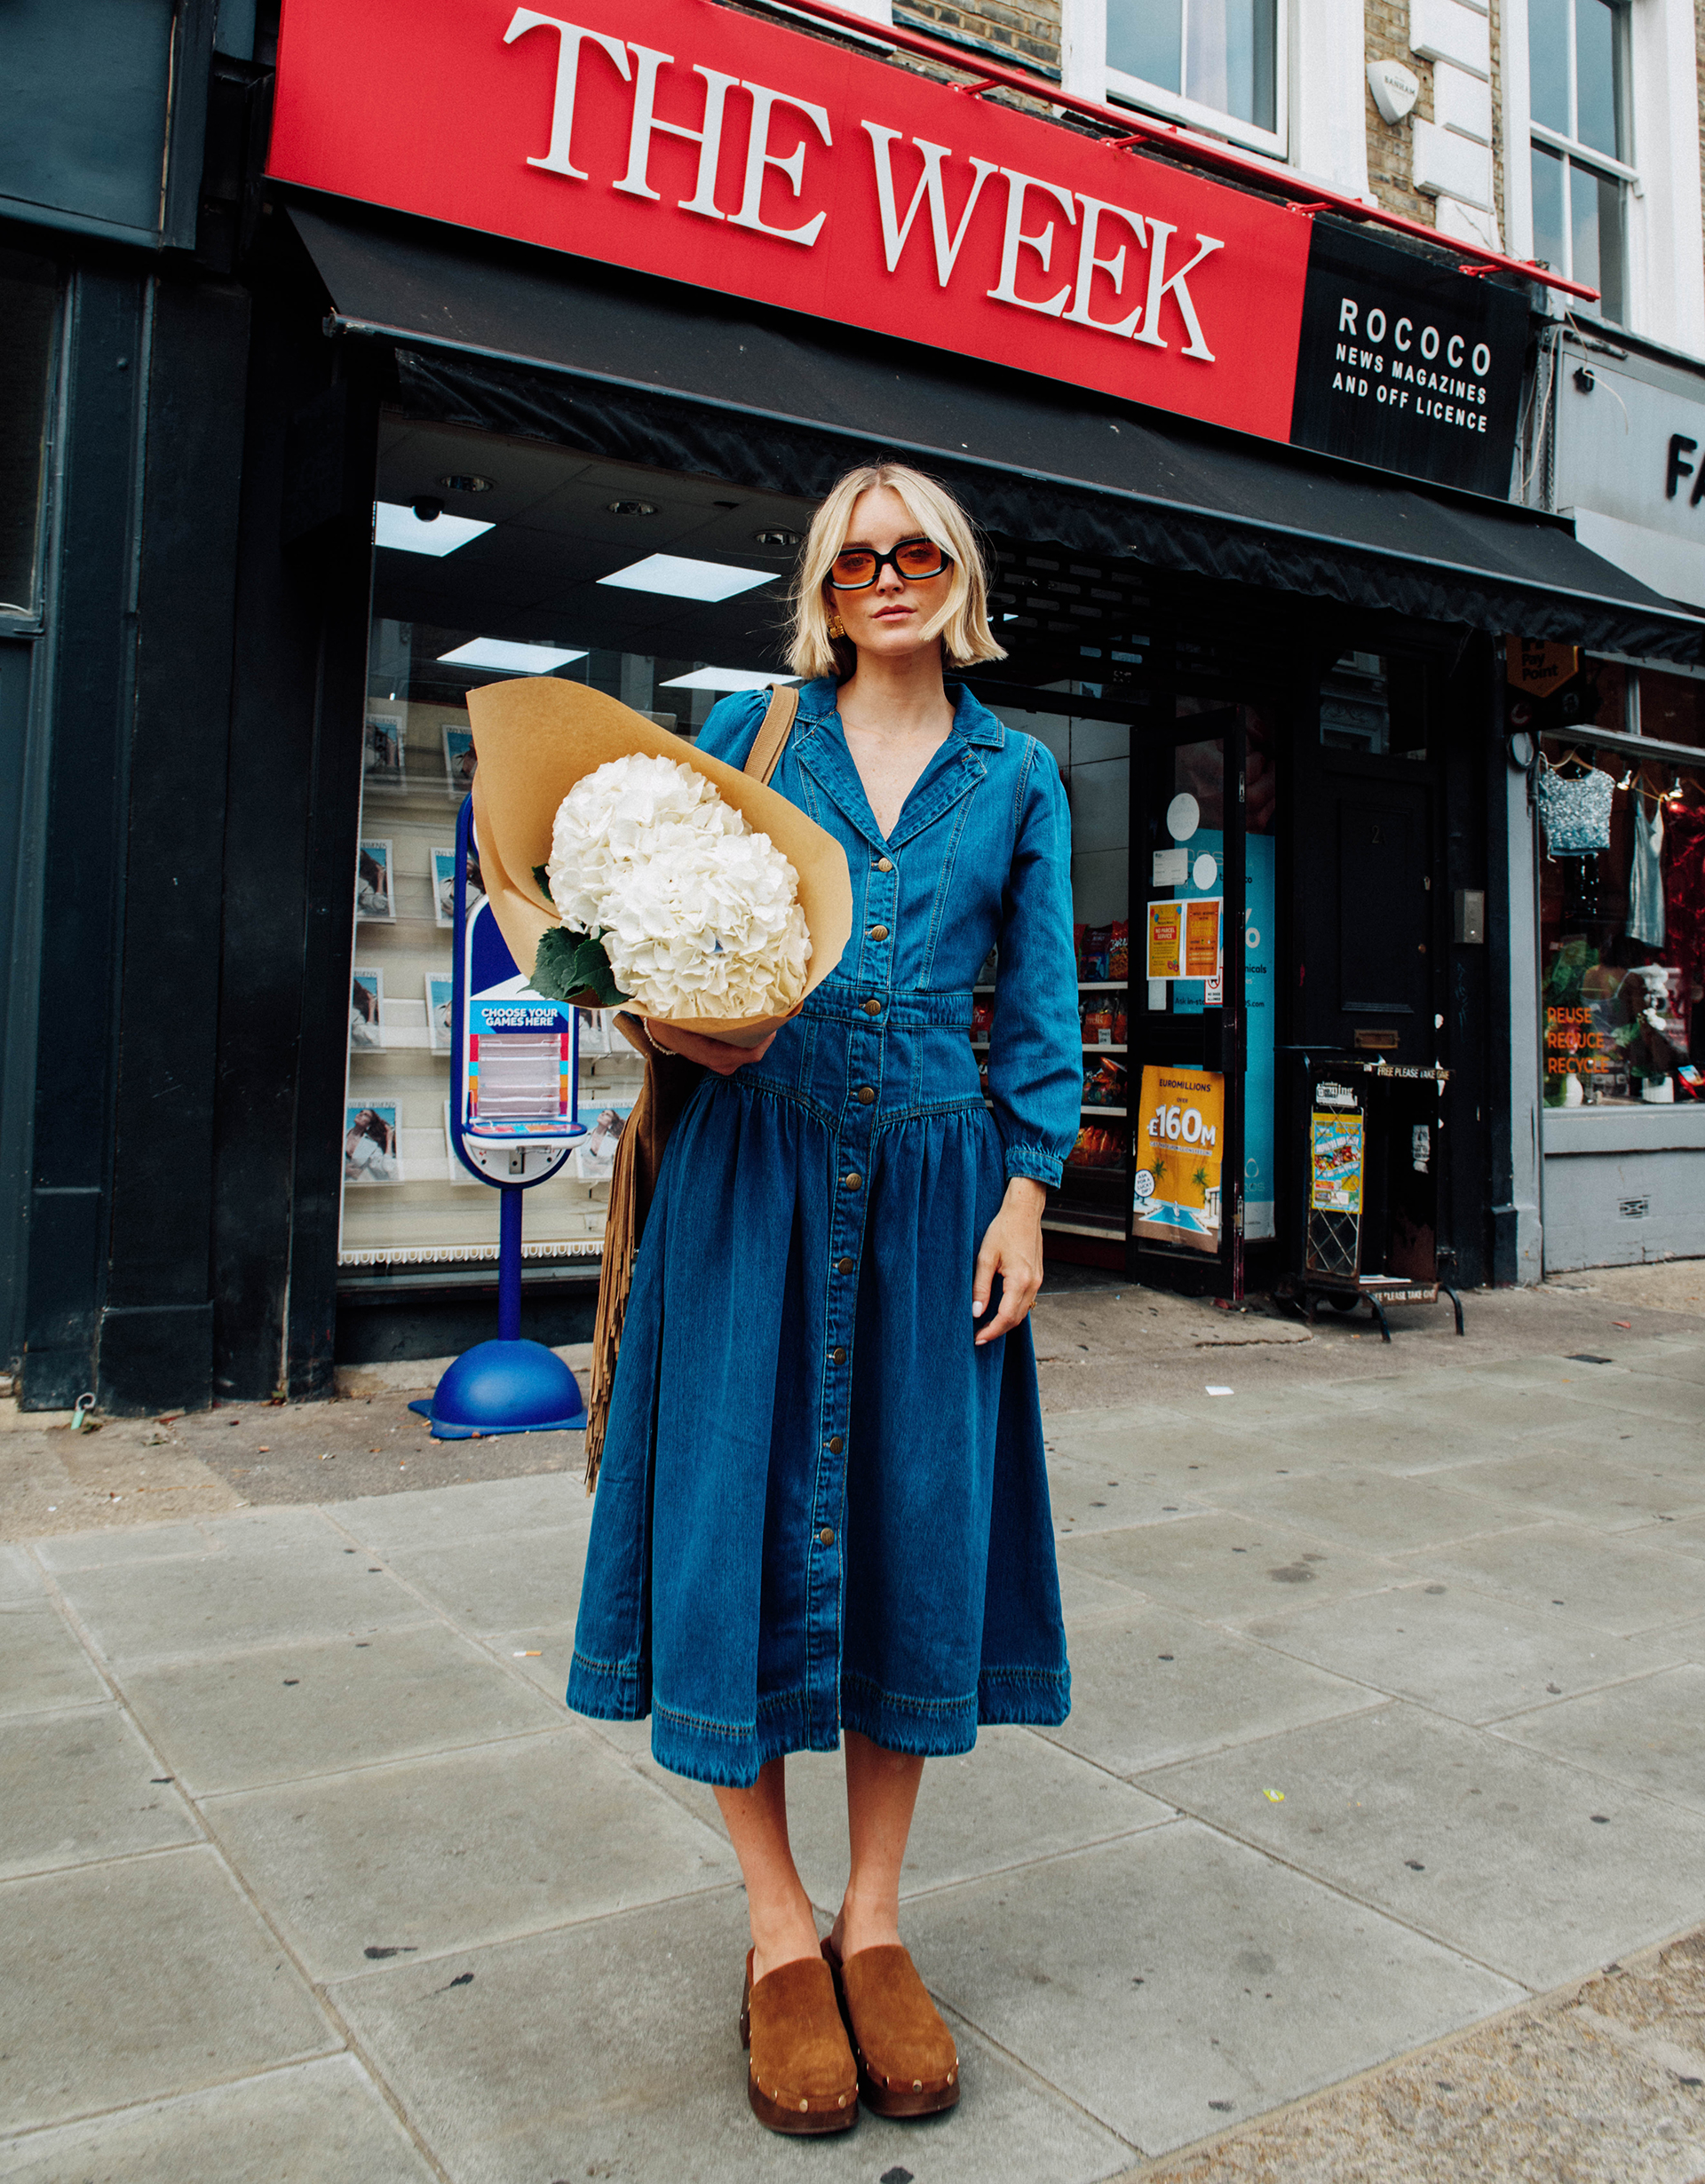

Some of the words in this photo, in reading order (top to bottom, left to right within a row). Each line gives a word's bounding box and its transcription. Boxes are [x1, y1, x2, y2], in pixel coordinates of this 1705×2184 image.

[1384, 75, 1416, 95] BANHAM
[503, 7, 833, 247] THE
[860, 119, 1225, 362] WEEK
[1338, 297, 1491, 376] ROCOCO
[1336, 343, 1384, 373] NEWS
[1392, 360, 1487, 405] MAGAZINES
[1332, 372, 1368, 397] AND
[1376, 384, 1409, 408] OFF
[1416, 397, 1487, 432] LICENCE
[1522, 653, 1545, 668] Pay
[1522, 664, 1558, 681] Point
[481, 1008, 527, 1017] CHOOSE
[528, 1008, 559, 1017] YOUR
[1547, 1006, 1592, 1025] REUSE
[486, 1017, 524, 1026] GAMES
[525, 1017, 554, 1026] HERE
[1547, 1032, 1605, 1049] REDUCE
[1377, 1066, 1393, 1077] FREE
[1394, 1067, 1419, 1078] PLEASE
[1420, 1069, 1436, 1080] TAKE
[1548, 1056, 1610, 1074] RECYCLE
[1159, 1079, 1211, 1092] EUROMILLIONS
[1146, 1104, 1216, 1146] £160M
[1168, 1143, 1194, 1153] EUROMILLIONS
[1407, 1290, 1423, 1300] TAKE
